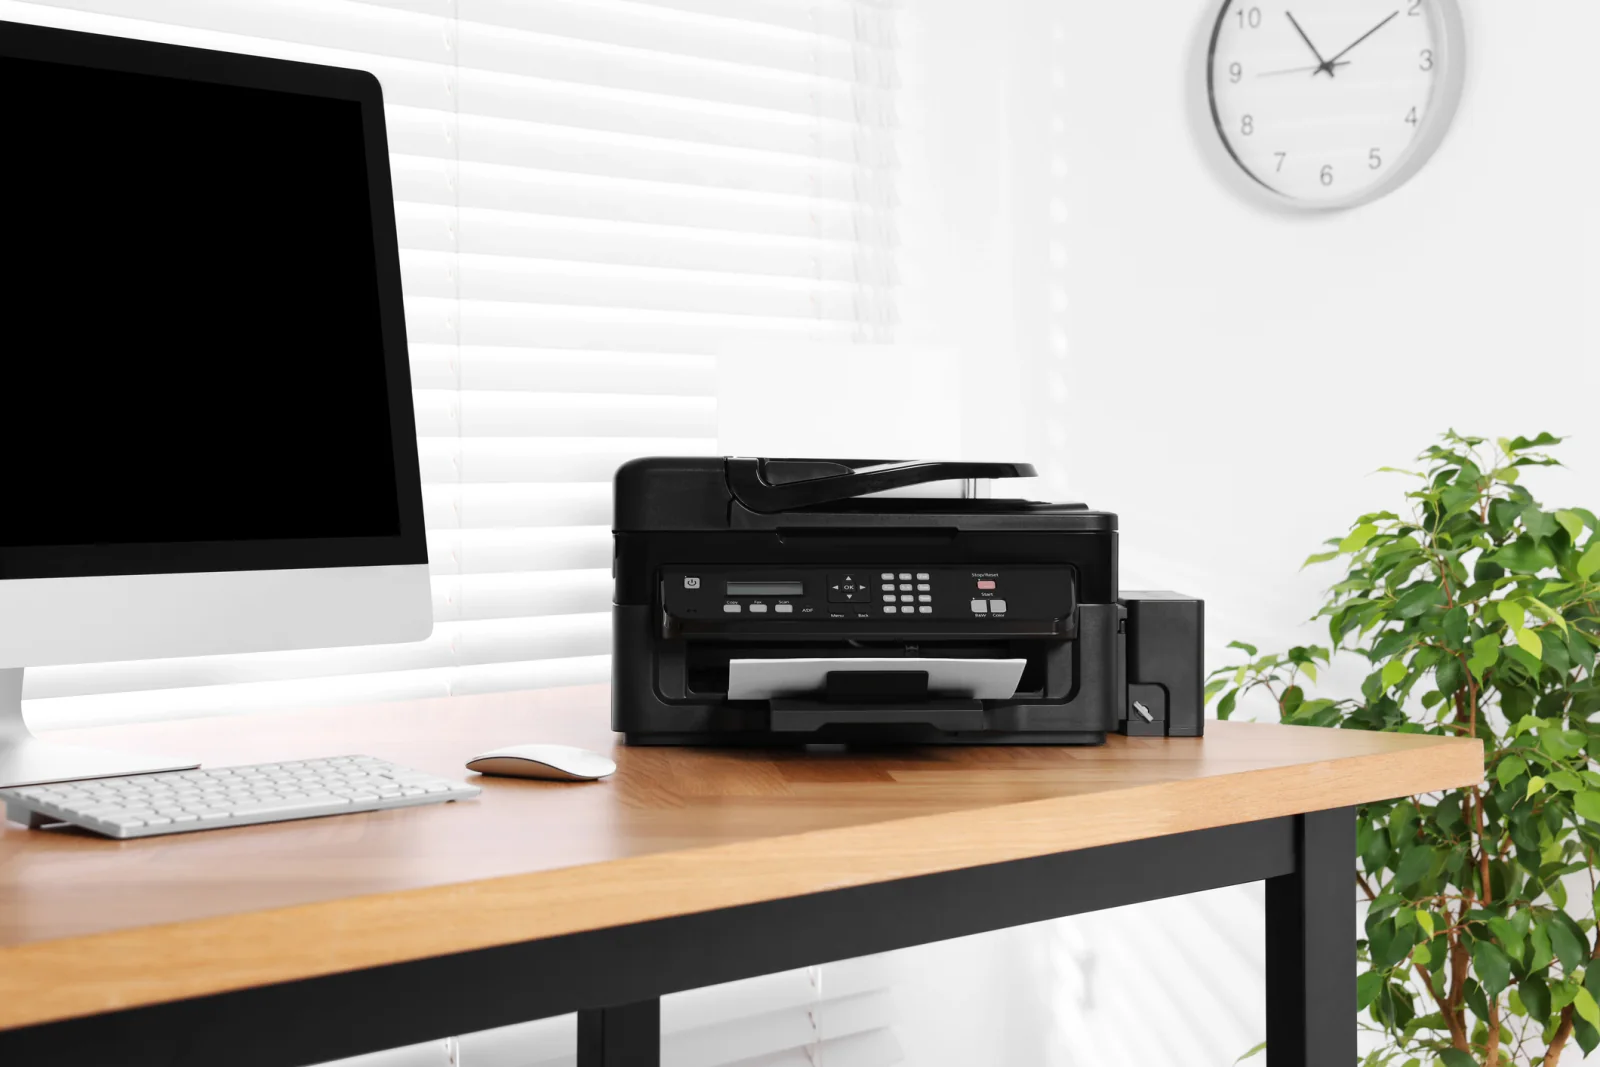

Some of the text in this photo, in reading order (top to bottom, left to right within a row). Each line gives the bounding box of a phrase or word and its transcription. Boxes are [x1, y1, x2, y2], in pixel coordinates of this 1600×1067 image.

[1236, 7, 1262, 29] 10
[1407, 0, 1421, 16] 2
[1419, 48, 1434, 71] 3
[1229, 62, 1242, 84] 9
[1240, 114, 1254, 136] 8
[1404, 106, 1418, 128] 4
[1273, 151, 1286, 172] 7
[1368, 147, 1382, 170] 5
[1319, 164, 1334, 187] 6
